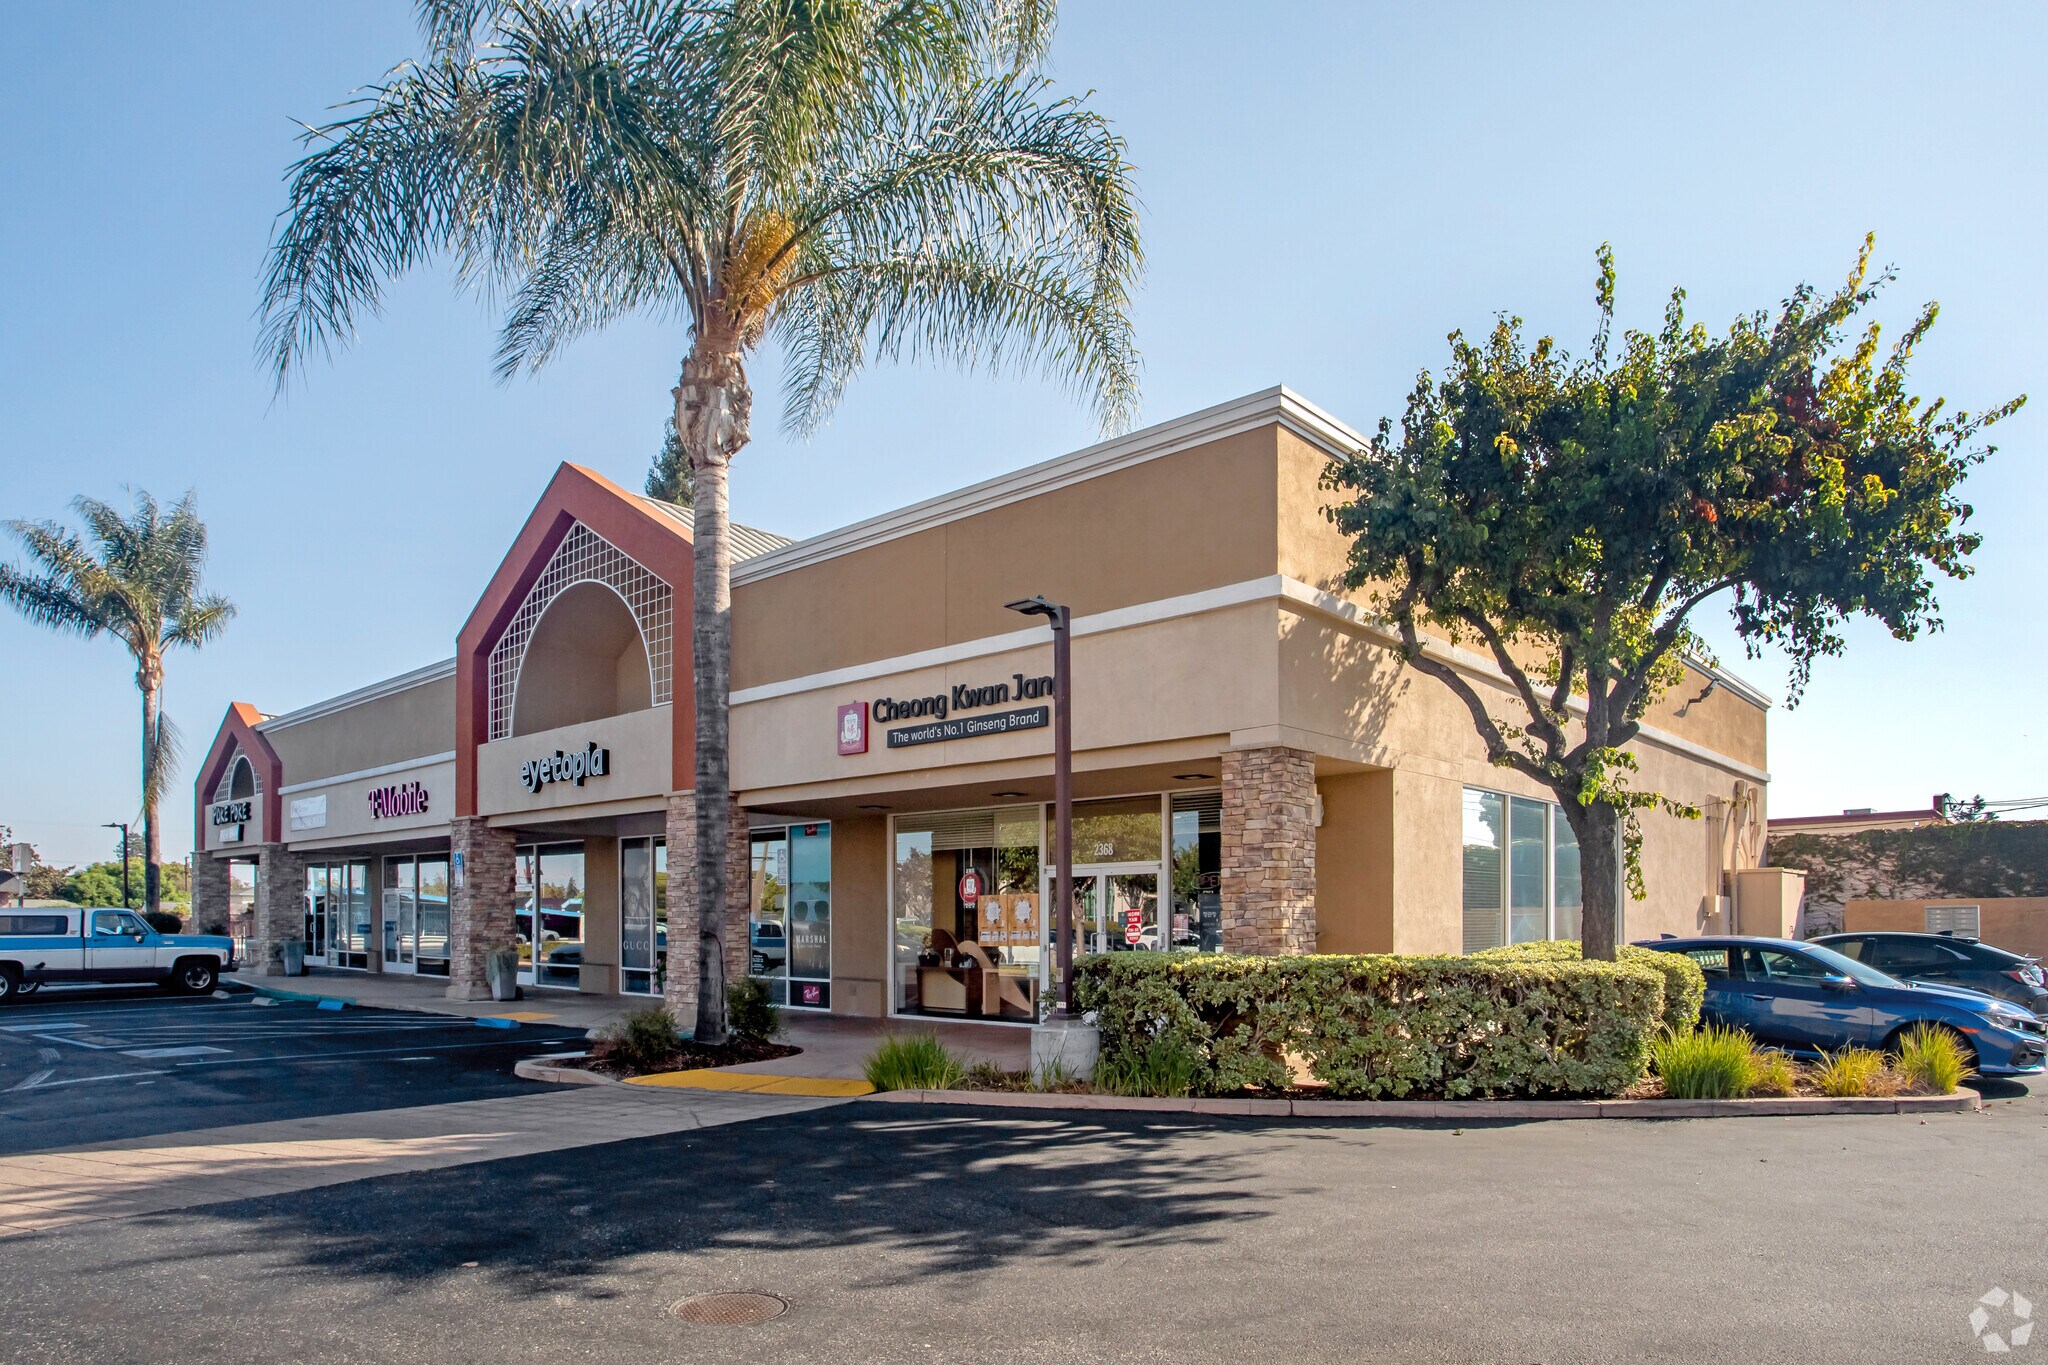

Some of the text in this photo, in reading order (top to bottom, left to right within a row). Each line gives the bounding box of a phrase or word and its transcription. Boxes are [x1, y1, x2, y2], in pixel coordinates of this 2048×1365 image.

[872, 673, 1056, 723] Cheong Kwan Jan
[893, 711, 1039, 744] The world's No.1 Ginseng Brand
[520, 741, 608, 793] eyetopia
[368, 781, 427, 819] T-Mobile
[1094, 843, 1113, 855] 2368
[796, 934, 827, 944] MARSHAL
